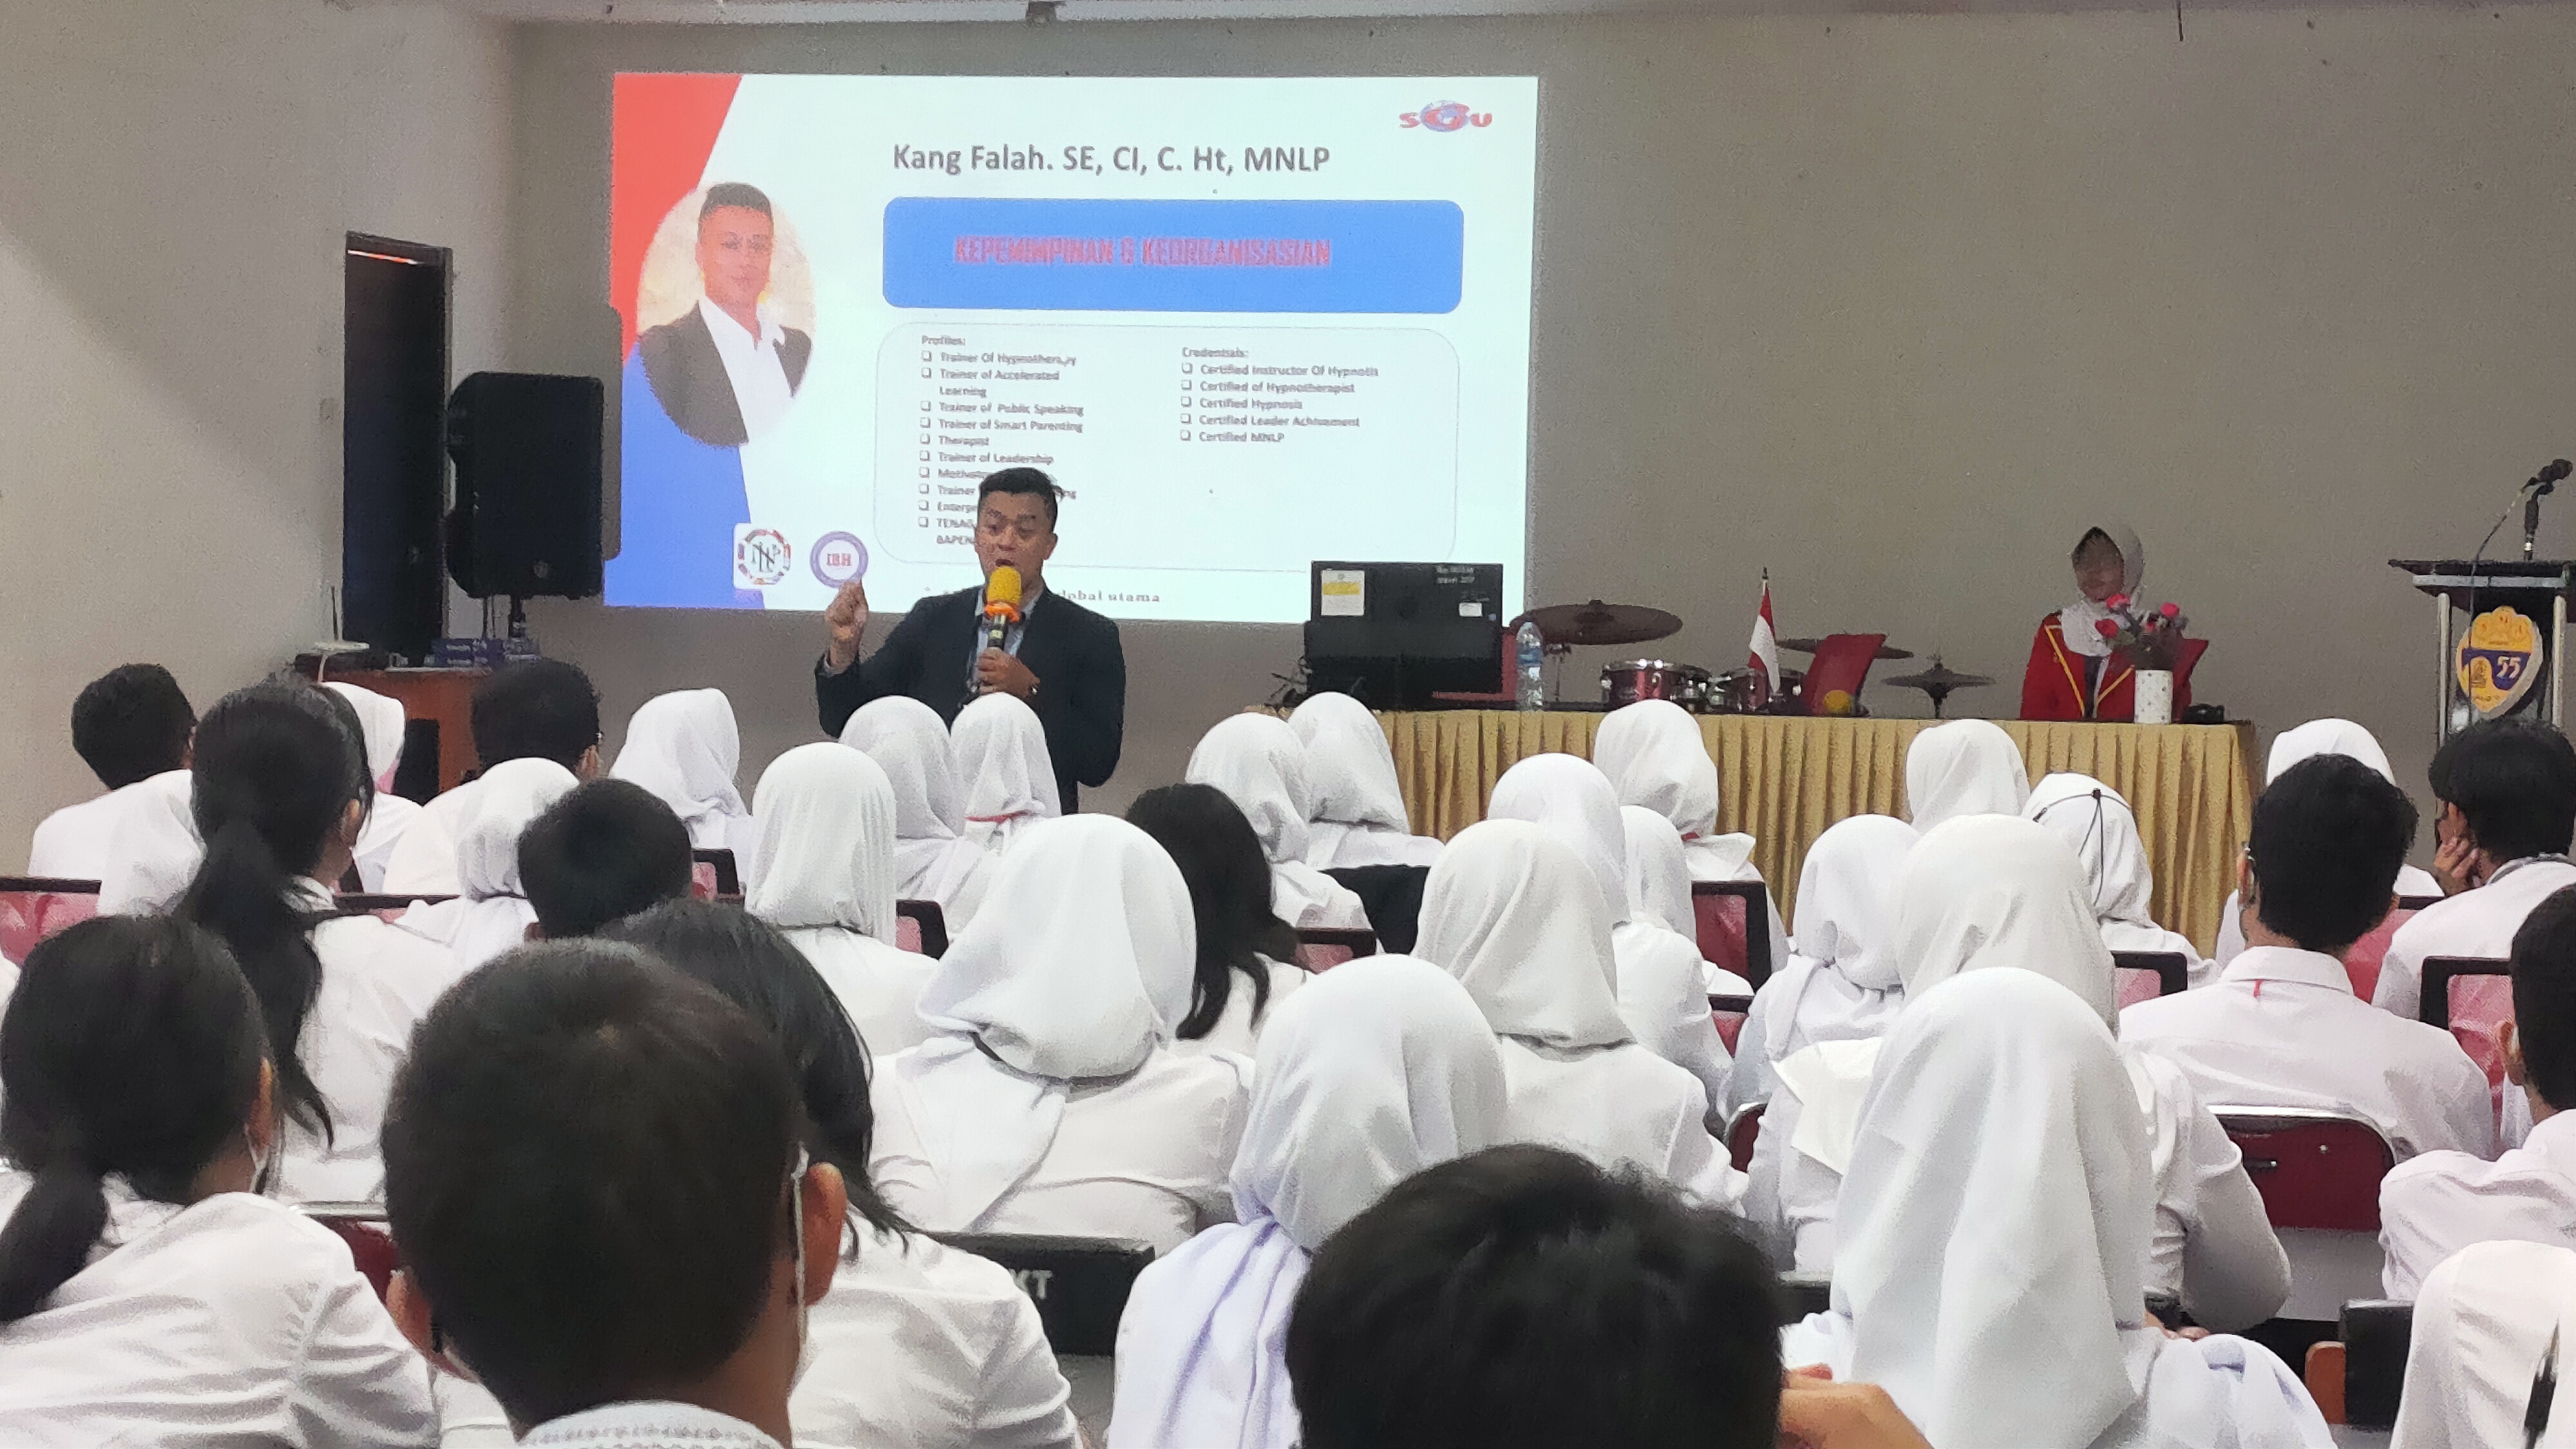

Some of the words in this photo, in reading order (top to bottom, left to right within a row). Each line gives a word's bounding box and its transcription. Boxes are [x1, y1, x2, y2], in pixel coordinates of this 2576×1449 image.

[893, 144, 961, 176] Kang
[971, 144, 1054, 171] Falah.
[1063, 145, 1103, 176] SE,
[1113, 146, 1148, 176] CI,
[1157, 146, 1182, 171] C.
[1193, 146, 1234, 176] Ht,
[1244, 146, 1331, 172] MNLP
[940, 352, 978, 363] Trainer
[981, 352, 994, 363] Of
[940, 368, 978, 379] Trainer
[981, 370, 992, 379] of
[994, 370, 1060, 381] Accelerated
[1200, 364, 1249, 375] Certified
[1252, 366, 1308, 375] Instructor
[1311, 365, 1325, 375] Of
[940, 386, 987, 398] Learning
[1200, 381, 1249, 392] Certified
[1252, 381, 1264, 392] of
[1267, 383, 1355, 395] Hypnotherapist
[939, 402, 977, 412] Trainer
[980, 402, 992, 413] of
[998, 403, 1030, 413] Public
[1034, 404, 1084, 417] Speaking
[1200, 397, 1248, 408] Certified
[1251, 398, 1303, 411] Hypnosis
[938, 419, 976, 430] Trainer
[980, 419, 992, 430] of
[994, 419, 1027, 430] Smart
[1030, 420, 1083, 433] Parenting
[1199, 415, 1247, 425] Certified
[1251, 415, 1290, 426] Leader
[938, 435, 990, 448] Therapist
[1199, 431, 1247, 442] Certified
[1251, 432, 1285, 443] MNLP
[938, 451, 977, 462] Trainer
[979, 452, 990, 462] of
[993, 453, 1055, 466] Leadership
[938, 484, 976, 495] Trainer
[1058, 589, 1103, 601] lobal
[1108, 592, 1160, 602] utama
